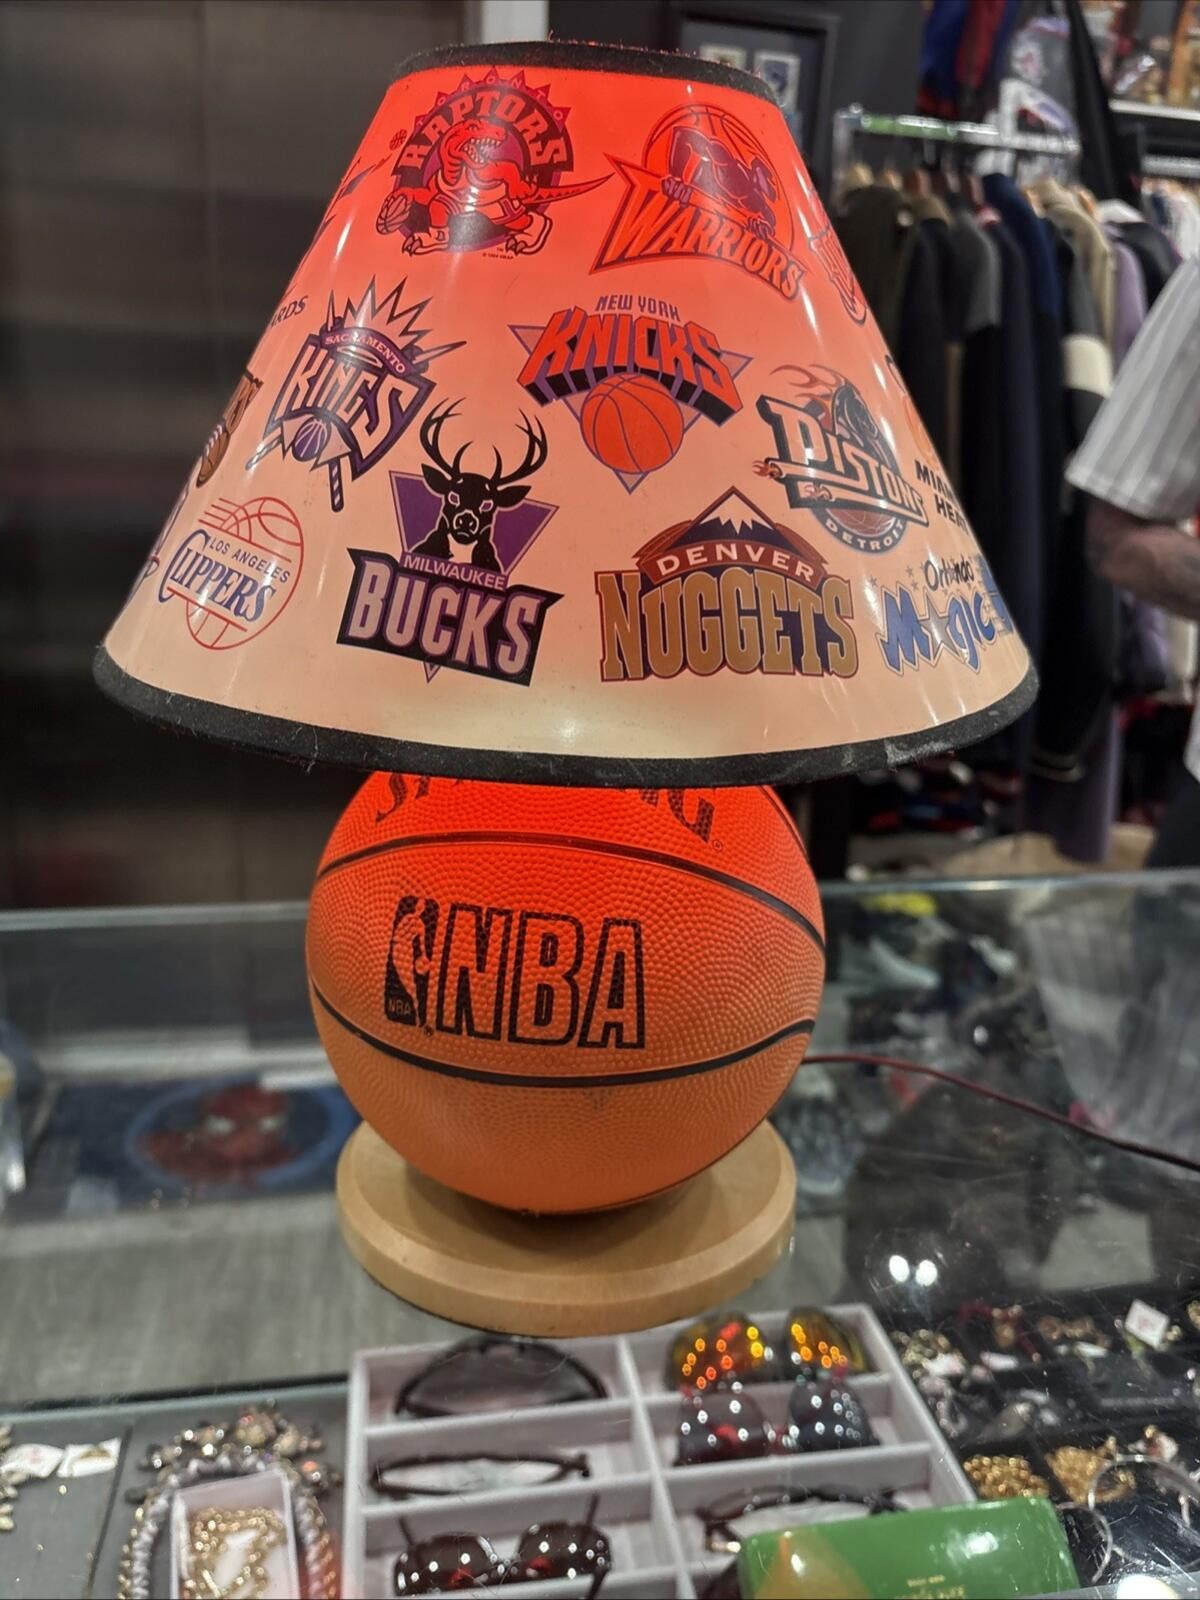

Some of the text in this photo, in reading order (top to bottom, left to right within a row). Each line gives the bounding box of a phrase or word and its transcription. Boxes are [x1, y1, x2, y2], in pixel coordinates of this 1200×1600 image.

[400, 90, 569, 169] RAPTORS
[590, 168, 804, 301] WARRIORS
[595, 295, 680, 321] NEW YORK
[266, 340, 428, 470] KINGS
[517, 305, 744, 425] KNICKS
[757, 396, 929, 526] PISTONS
[914, 459, 961, 508] MIA
[159, 529, 276, 622] CLIPPERS
[209, 537, 291, 584] LOS ANGELES
[403, 554, 505, 590] MILWAUKEE
[656, 543, 815, 582] DENVER
[825, 518, 904, 551] DETROIT
[348, 556, 546, 674] BUCKS
[594, 566, 859, 682] NUGGETS
[436, 902, 646, 1049] NBA
